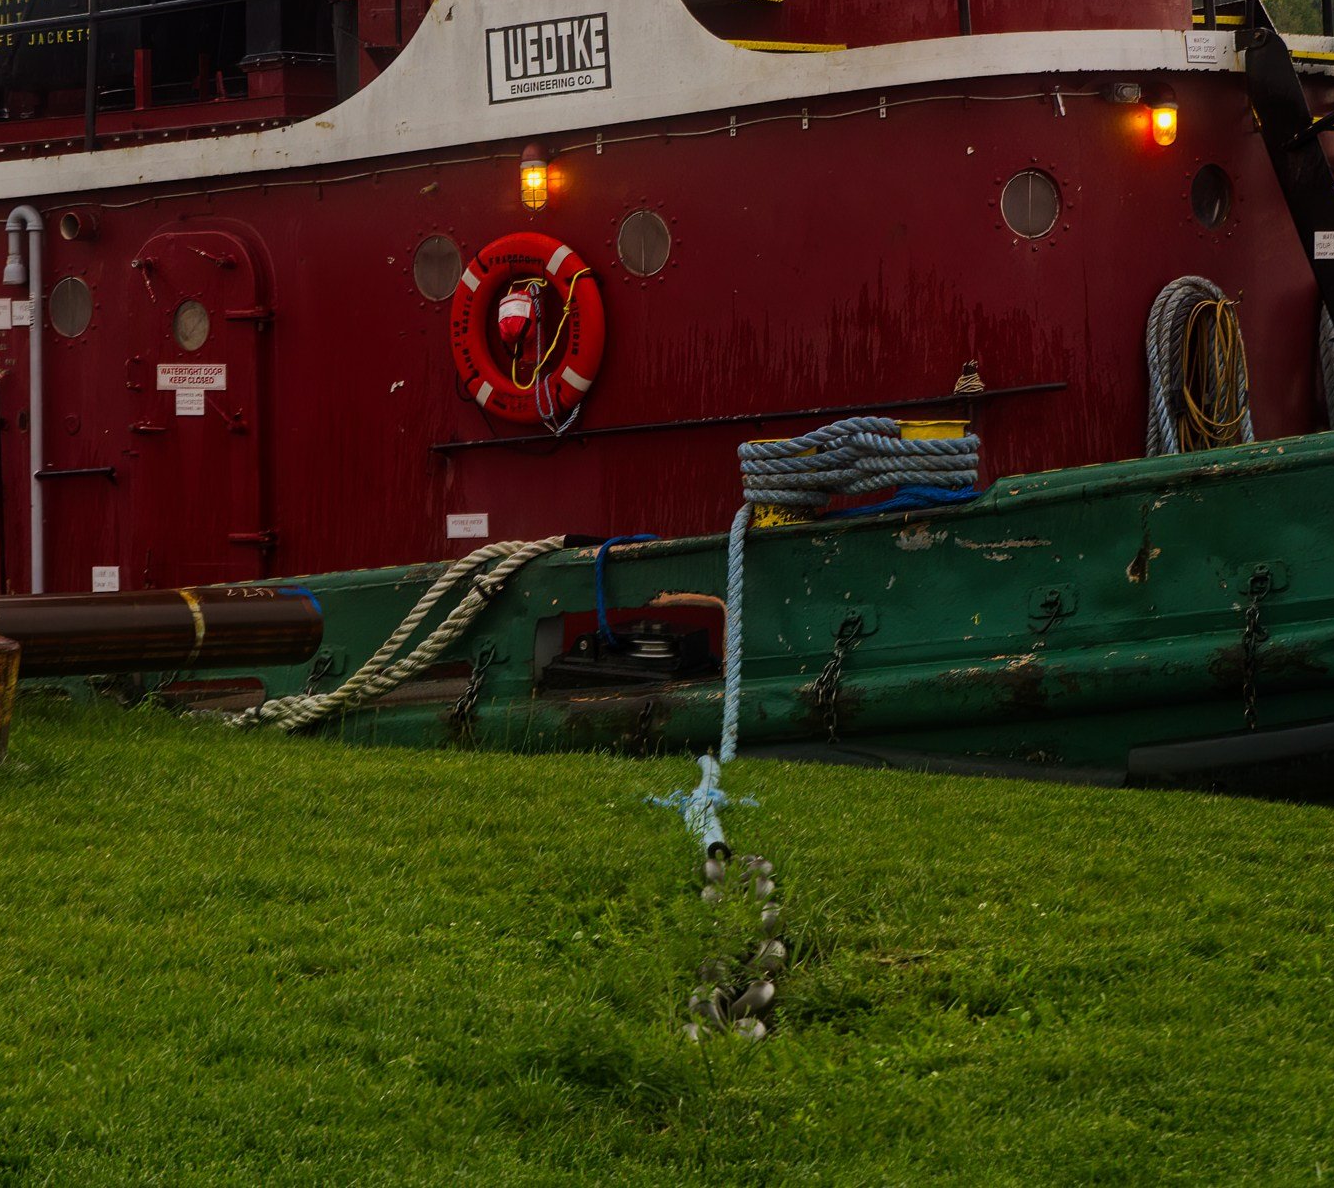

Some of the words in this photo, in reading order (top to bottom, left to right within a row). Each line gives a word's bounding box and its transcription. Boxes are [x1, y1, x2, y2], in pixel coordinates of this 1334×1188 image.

[489, 16, 606, 102] LUEDTKE
[510, 76, 576, 95] ENGINEERING
[577, 74, 595, 86] CO.
[160, 367, 202, 376] WATERTIGHT
[203, 367, 223, 376] DOOR
[169, 376, 187, 384] KEEP
[188, 376, 215, 384] CLOSED
